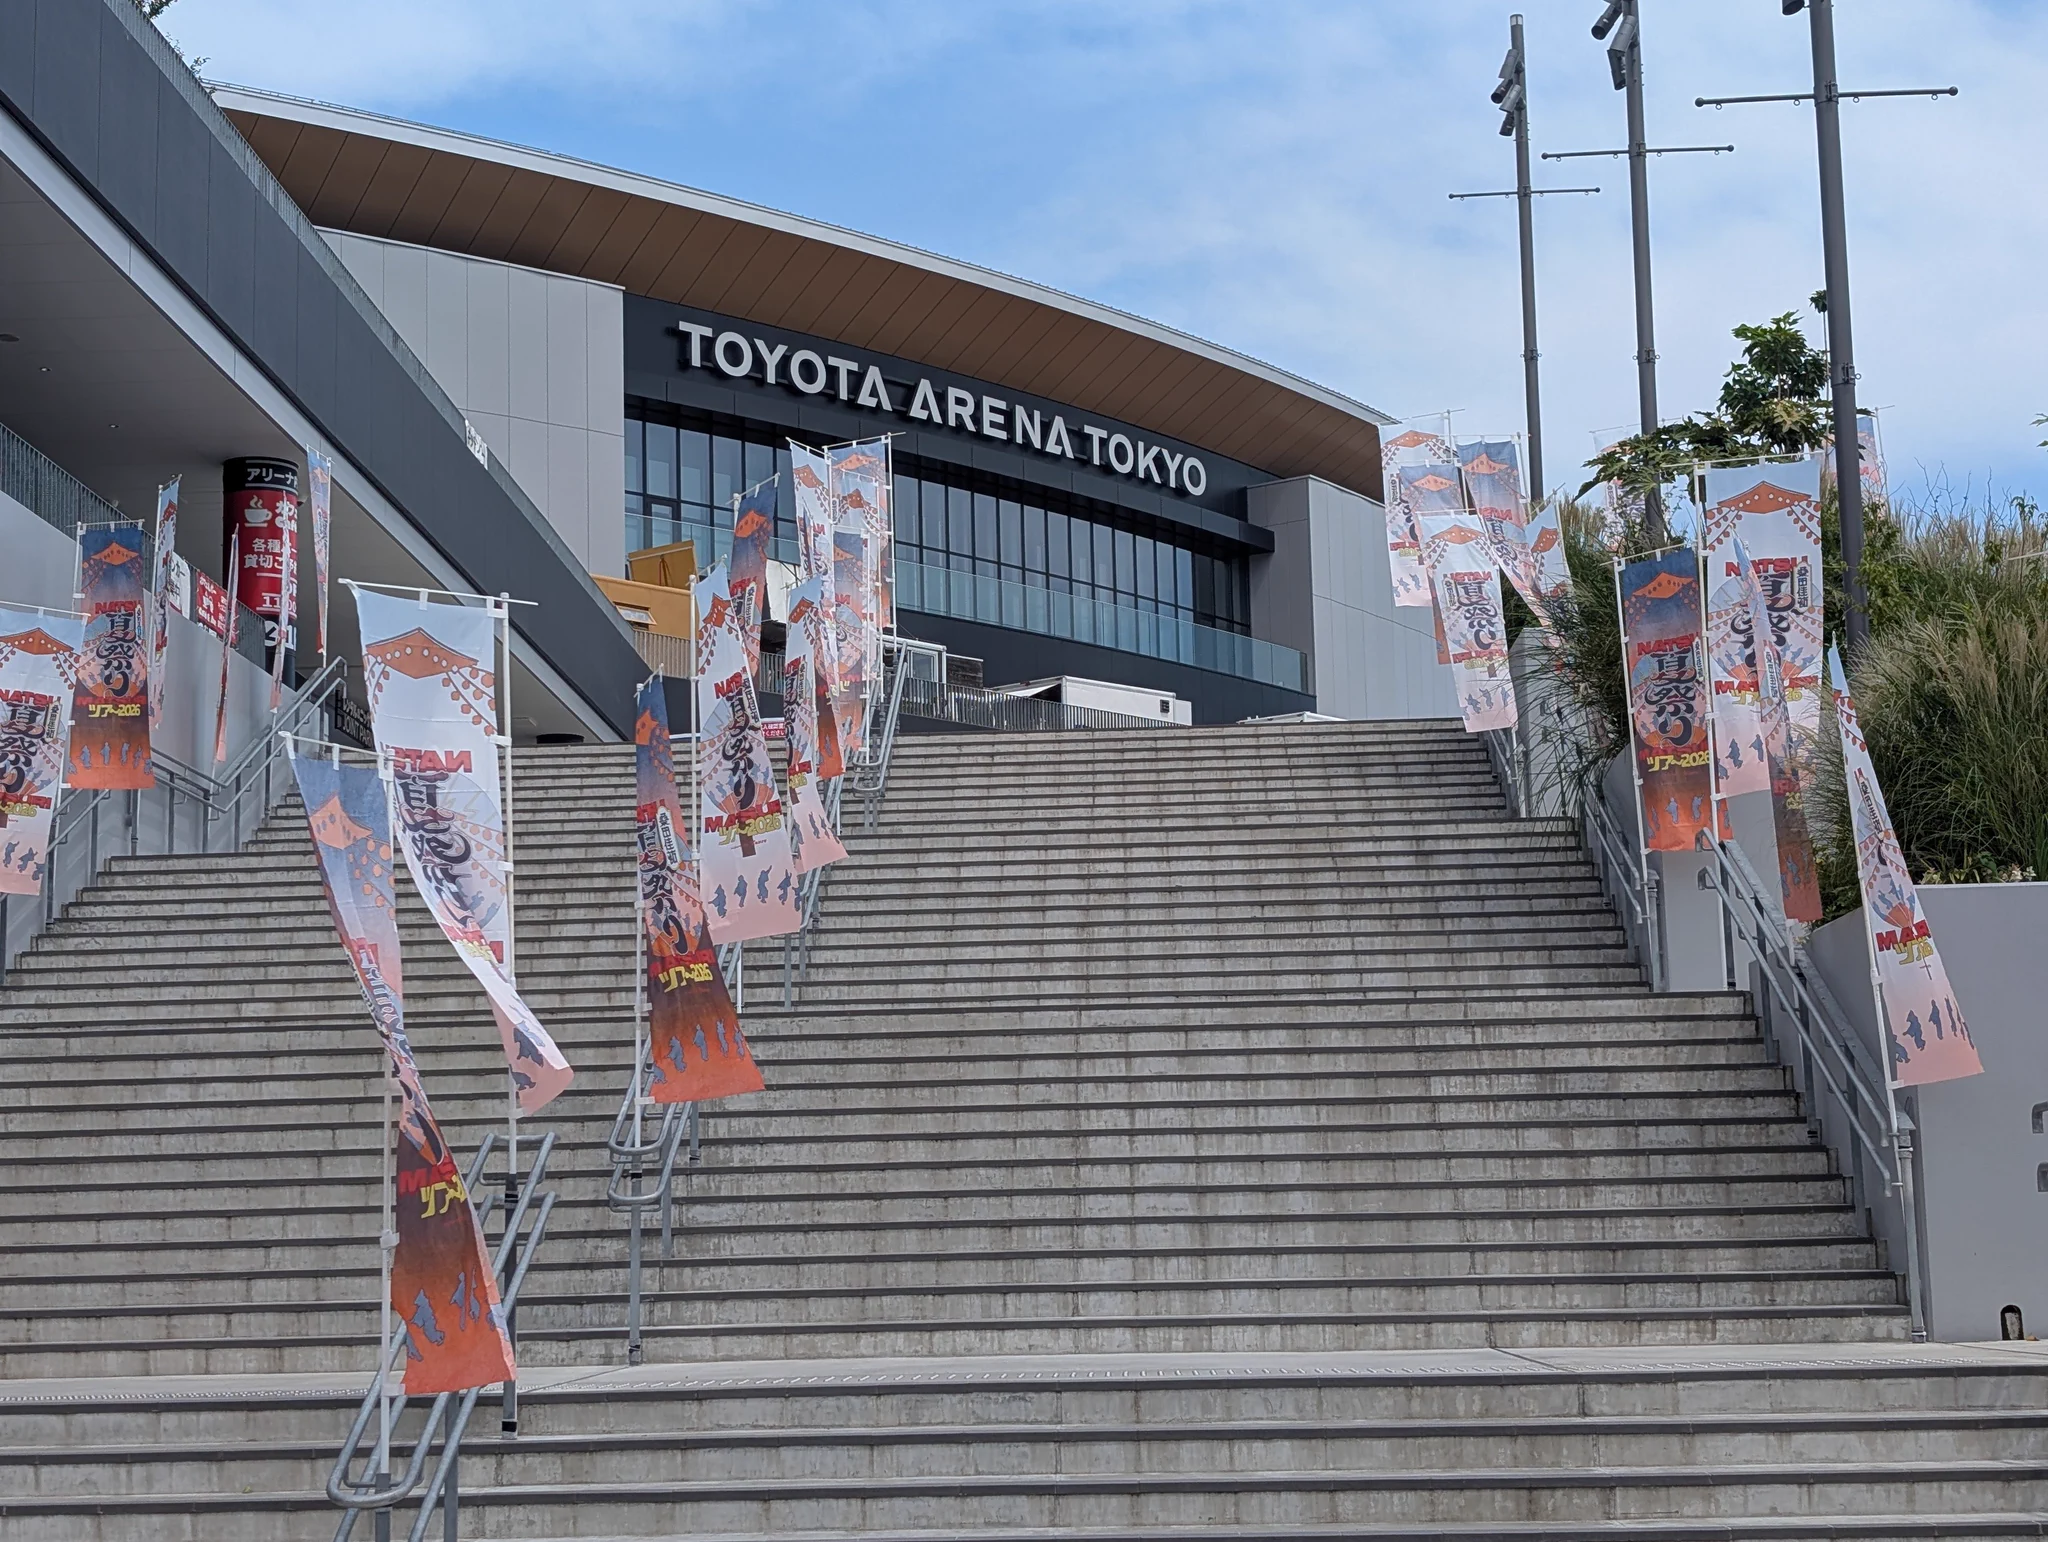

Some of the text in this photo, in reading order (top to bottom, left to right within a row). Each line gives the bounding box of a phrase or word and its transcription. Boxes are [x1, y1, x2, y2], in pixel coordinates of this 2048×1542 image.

[678, 320, 1207, 496] TOYOTA ARENA TOKYO
[96, 609, 140, 697] 夏祭り
[1645, 646, 1697, 747] 夏祭り
